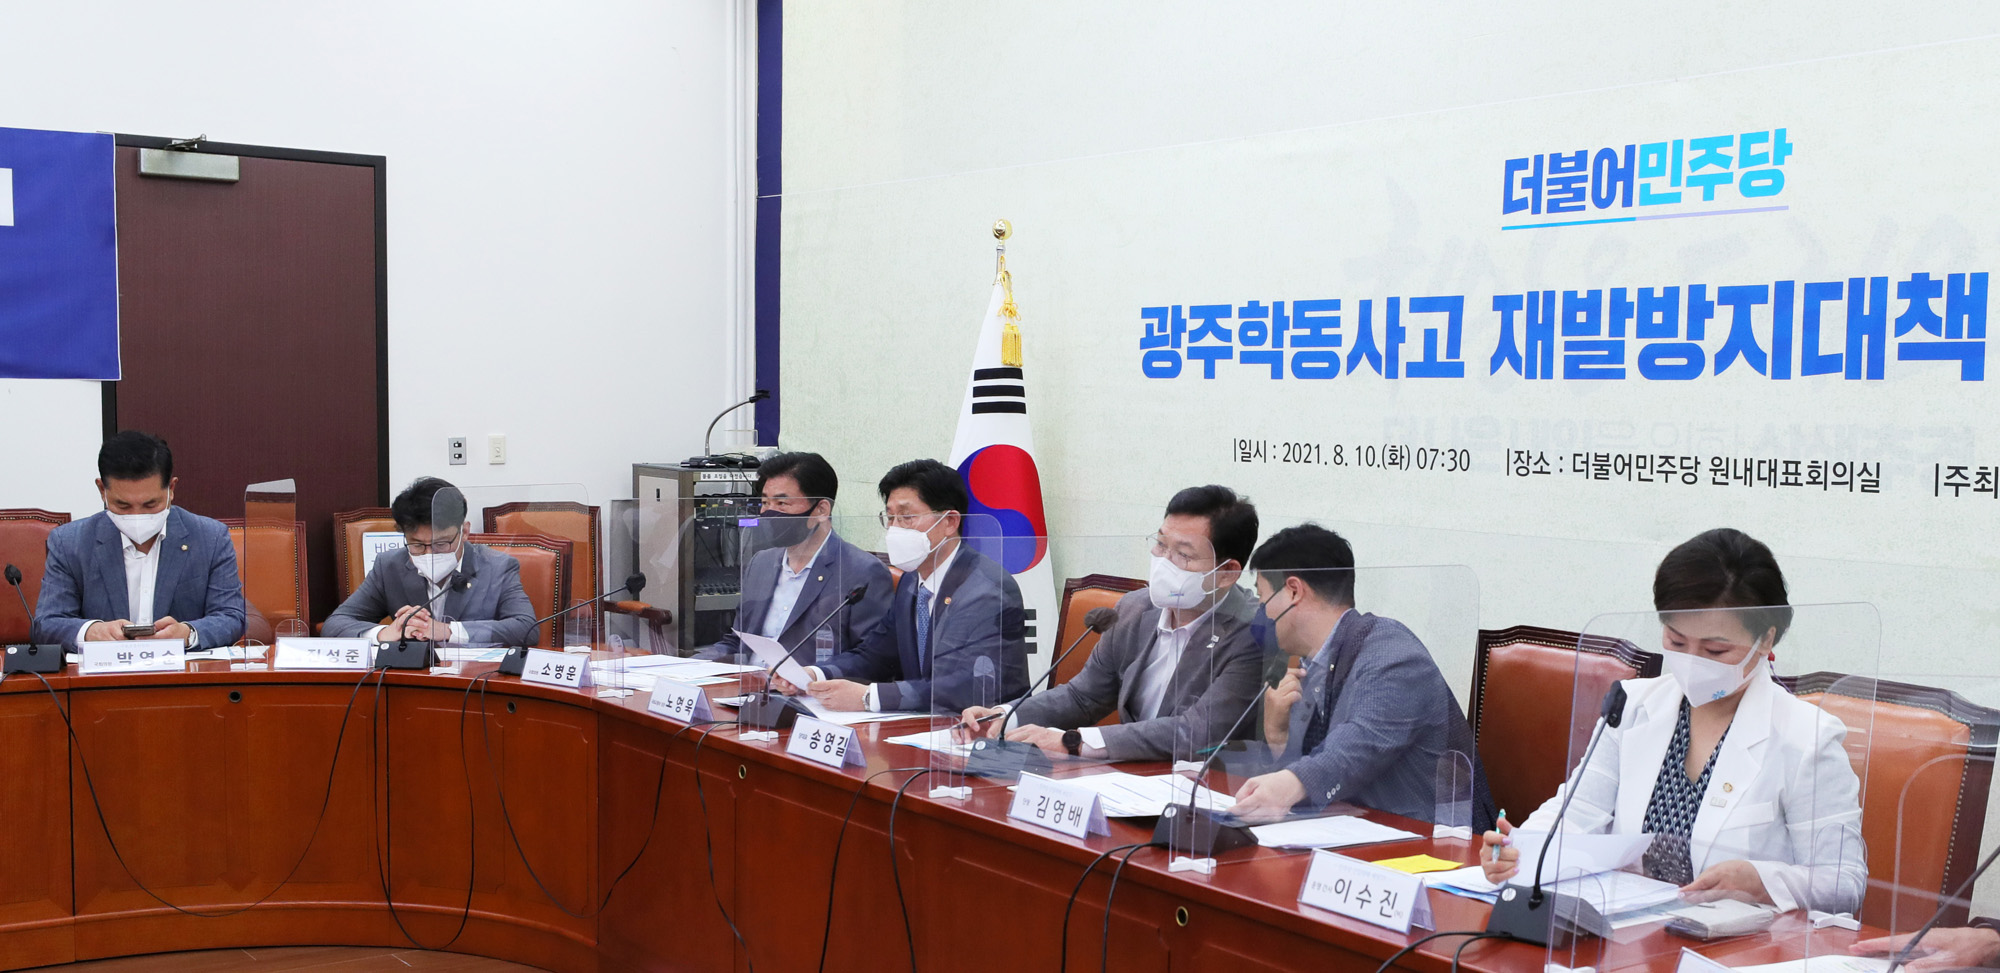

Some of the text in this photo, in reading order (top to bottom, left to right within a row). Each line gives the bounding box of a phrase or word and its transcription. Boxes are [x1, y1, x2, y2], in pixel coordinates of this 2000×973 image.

[1502, 128, 1793, 215] 더불어민주당
[1139, 271, 1990, 382] 광주학동사고 재발방지대책
[1282, 442, 1328, 466] 2021.
[1416, 447, 1471, 472] 07:30
[1572, 451, 1701, 485] 더불어민주당
[1708, 455, 1881, 494] 원내대표회의실
[809, 729, 849, 757] 송영길
[1036, 795, 1083, 828] 김영배
[1334, 878, 1398, 918] 이수진
